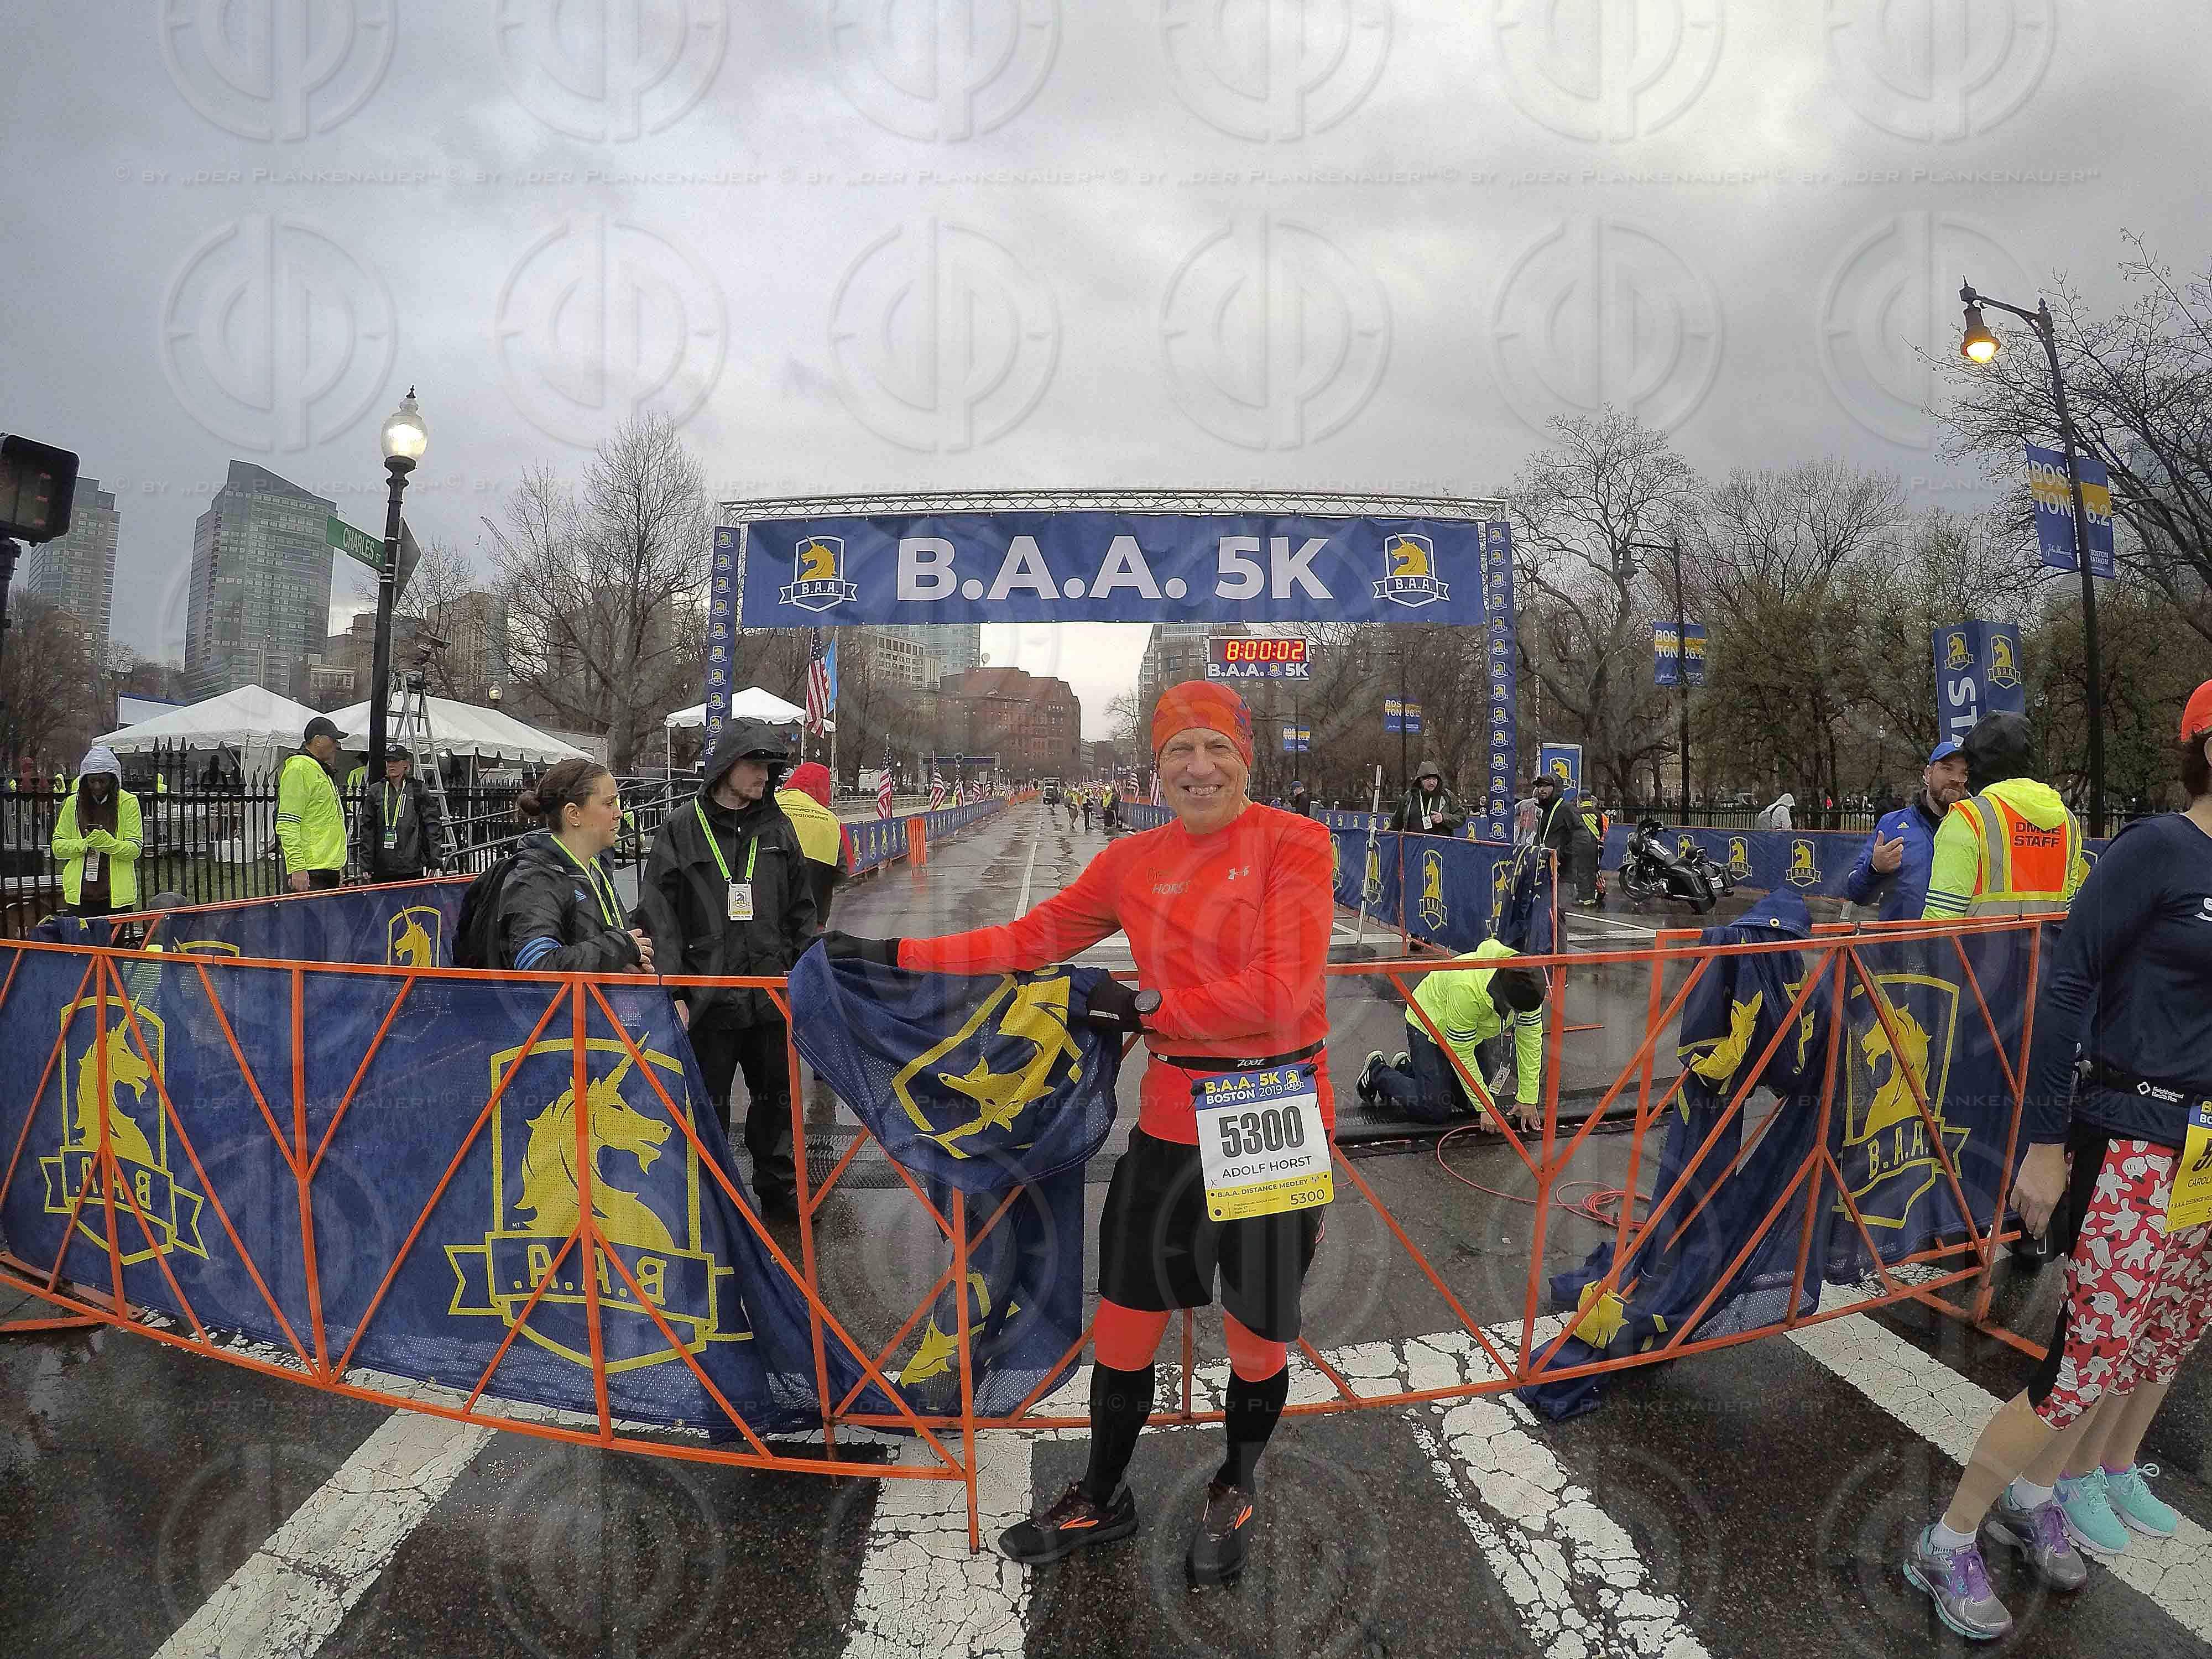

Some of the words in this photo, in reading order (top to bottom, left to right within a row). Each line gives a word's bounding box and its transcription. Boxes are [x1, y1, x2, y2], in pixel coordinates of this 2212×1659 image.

[2031, 460, 2067, 488] BOS
[2034, 489, 2072, 518] TON
[2085, 500, 2110, 526] 6.2
[343, 528, 375, 560] CHARLES
[897, 535, 1187, 601] B.A.A.
[1215, 535, 1334, 601] 5K
[801, 581, 839, 594] B.A.A.
[1395, 578, 1434, 591] B.A.A.
[1655, 629, 1678, 643] BOS
[1655, 645, 1679, 658] TON
[1208, 663, 1264, 678] B.A.A.
[1285, 663, 1309, 677] 5K
[1385, 699, 1402, 708] BOS
[2014, 836, 2060, 848] STAFF
[1204, 1076, 1255, 1094] B.A.A.
[1259, 1071, 1281, 1086] 5K
[1206, 1089, 1255, 1105] BOSTON
[1259, 1085, 1283, 1097] 2019
[1218, 1106, 1305, 1158] 5300
[1867, 1120, 1929, 1179] B.A.A.
[1222, 1163, 1266, 1179] ADOLF
[1269, 1155, 1312, 1172] HORST
[1241, 1184, 1277, 1195] DISTANCE
[1279, 1178, 1308, 1188] MEDLEY
[1291, 1189, 1326, 1206] 5300
